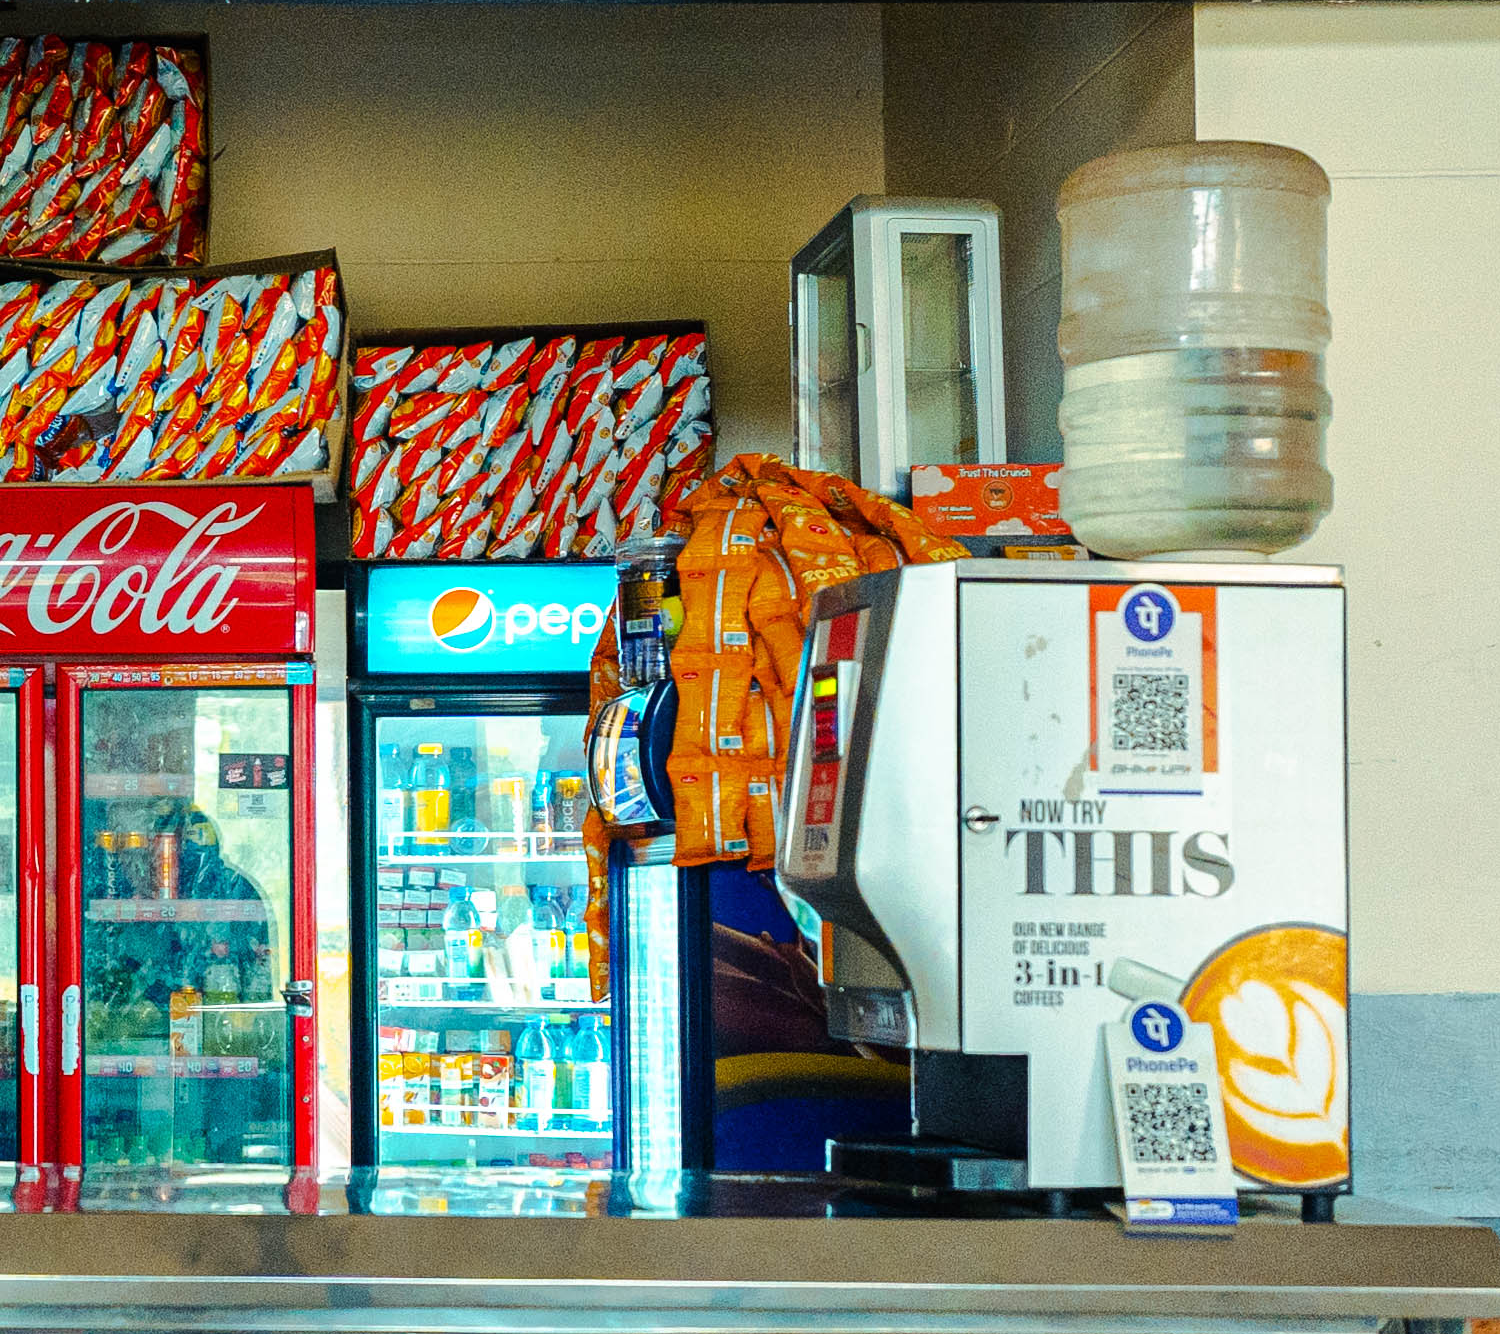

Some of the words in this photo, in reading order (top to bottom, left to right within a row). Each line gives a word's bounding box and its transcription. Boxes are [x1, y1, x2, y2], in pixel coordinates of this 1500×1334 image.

[959, 469, 981, 477] Trust
[983, 469, 999, 477] The
[1000, 469, 1031, 477] Crunch
[1021, 800, 1064, 823] NOW
[1071, 800, 1106, 823] TRY
[1004, 829, 1236, 898] THIS
[1013, 922, 1036, 936] OUR
[1039, 922, 1065, 936] NEW
[1015, 960, 1105, 987] 3-in-1
[1126, 1056, 1199, 1074] PhonePe
